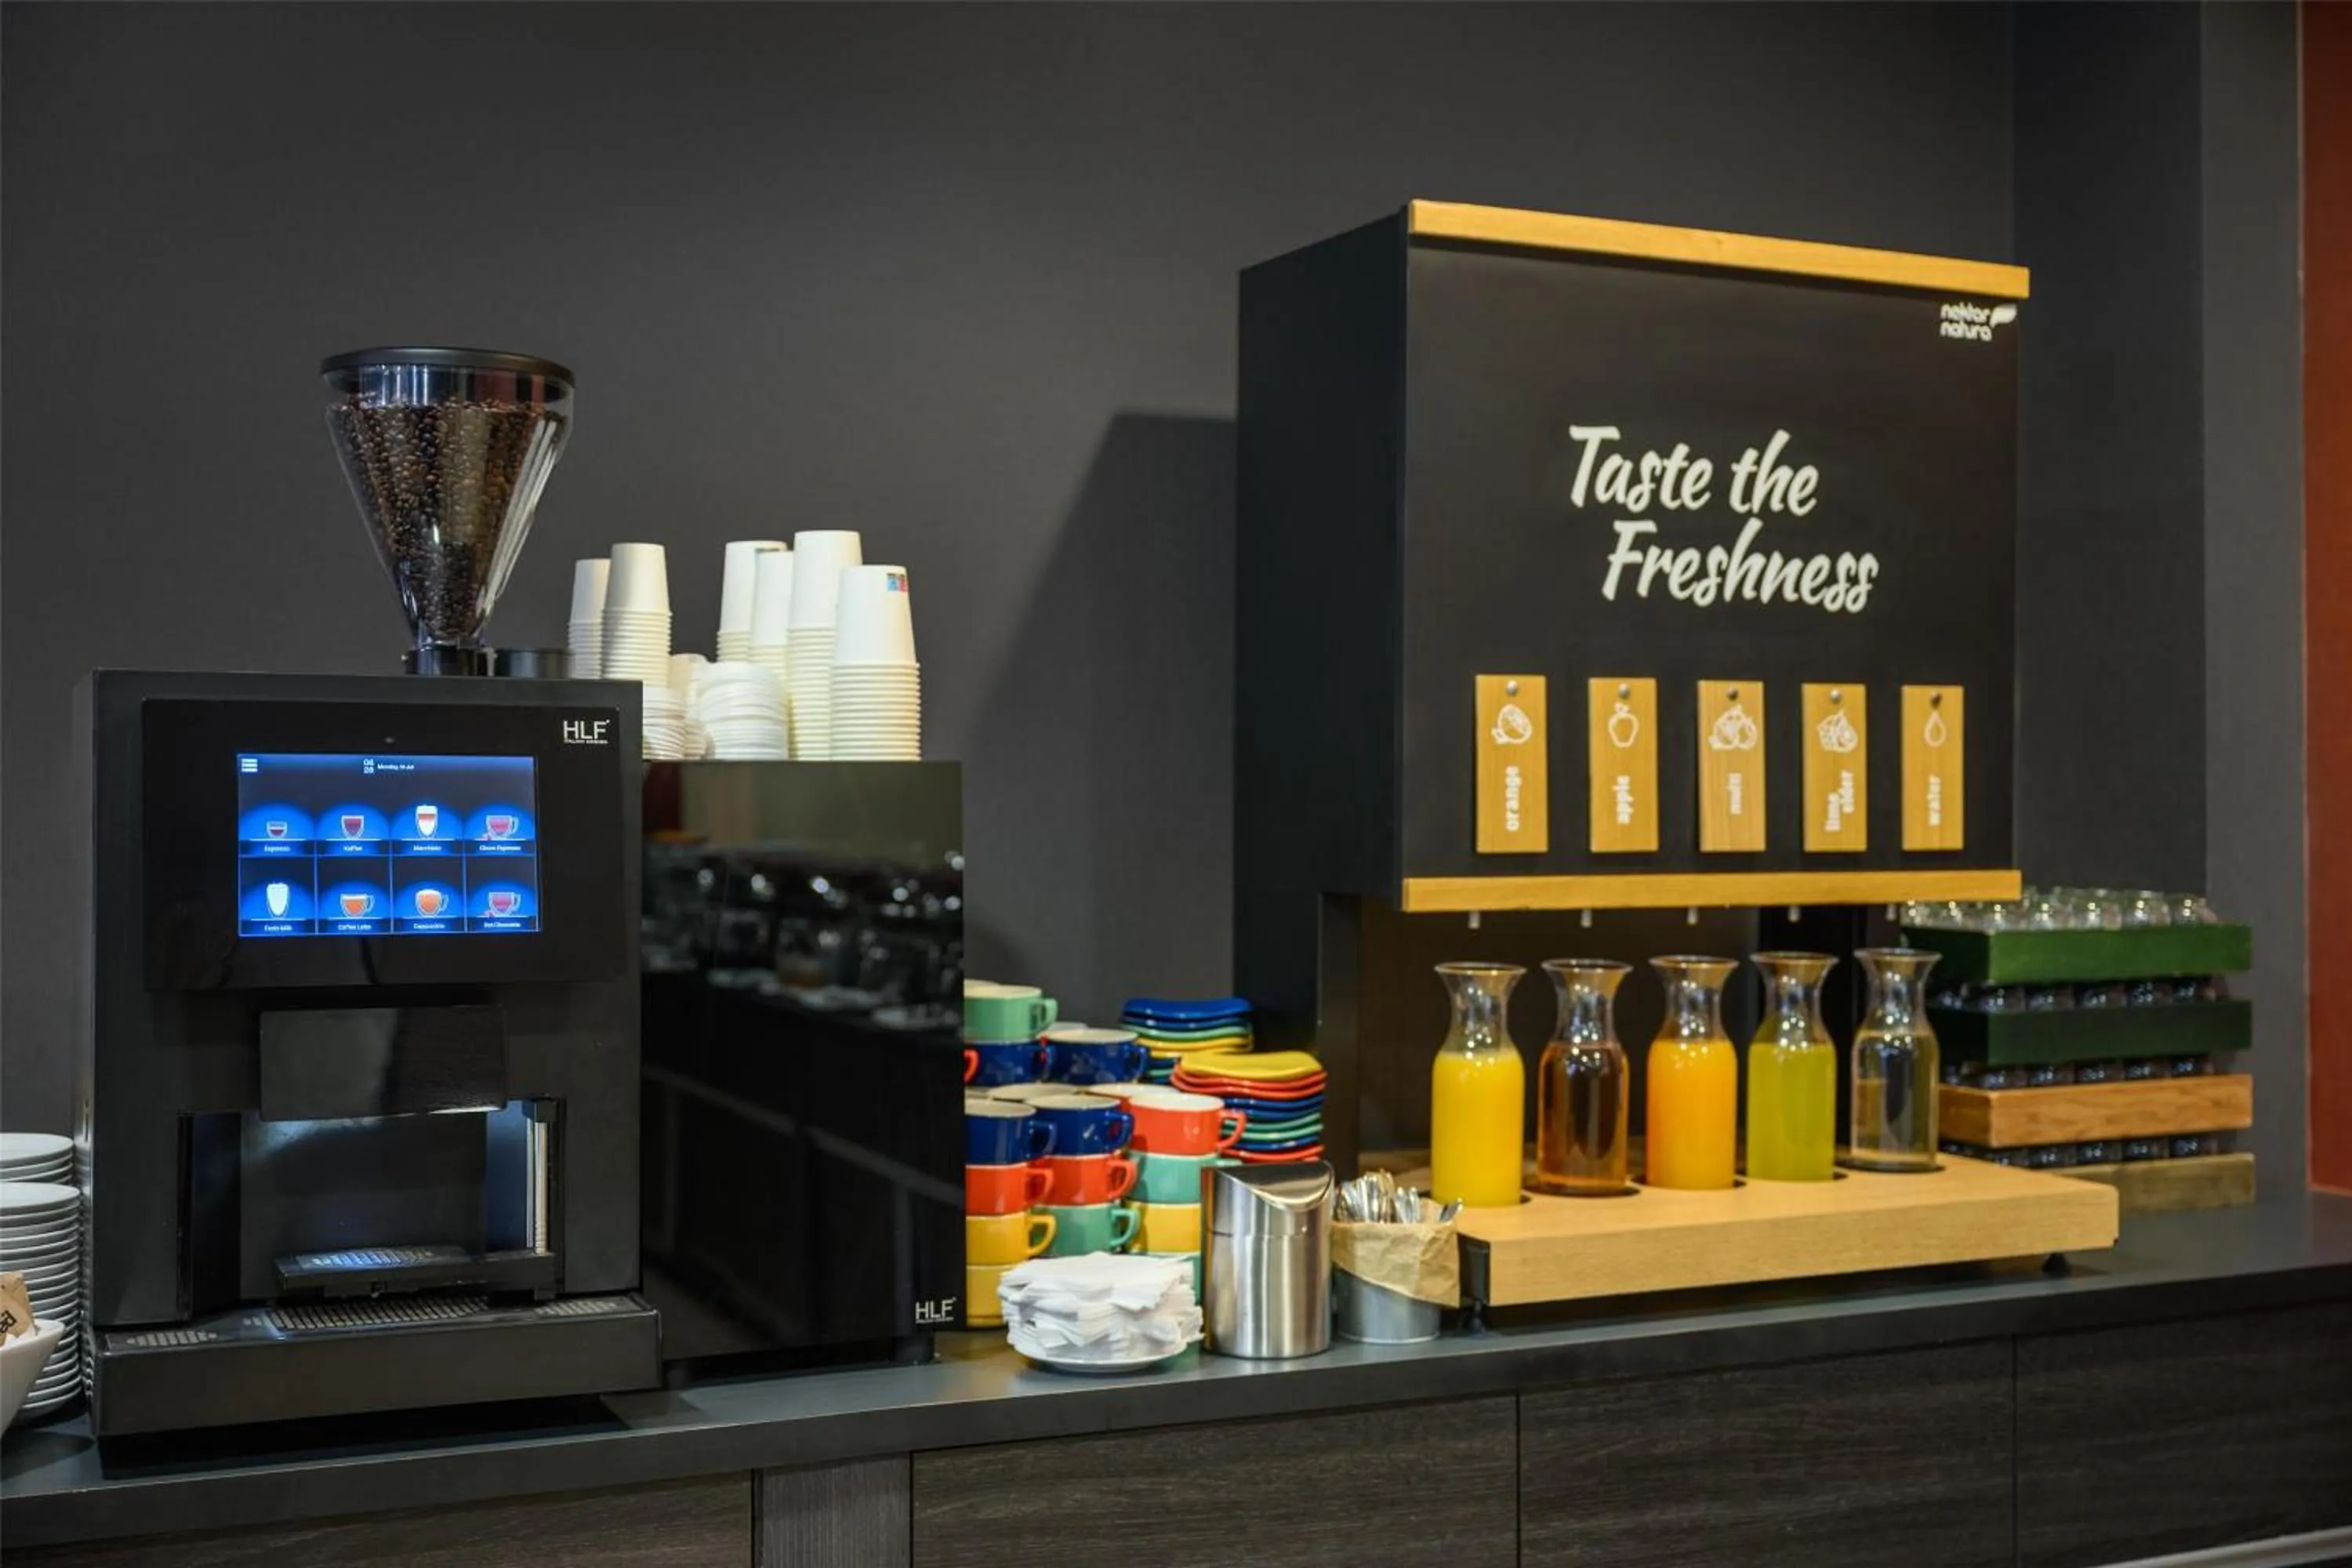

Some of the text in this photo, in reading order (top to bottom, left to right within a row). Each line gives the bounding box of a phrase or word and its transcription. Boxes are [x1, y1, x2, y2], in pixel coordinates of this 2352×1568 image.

[1940, 320, 1992, 342] natura
[1569, 424, 1820, 517] Taste the
[1601, 516, 1879, 613] Freshness
[564, 720, 608, 739] HLF
[1505, 765, 1522, 832] orange
[1613, 775, 1634, 825] apple
[1926, 774, 1941, 826] water
[915, 1299, 954, 1319] HLF
